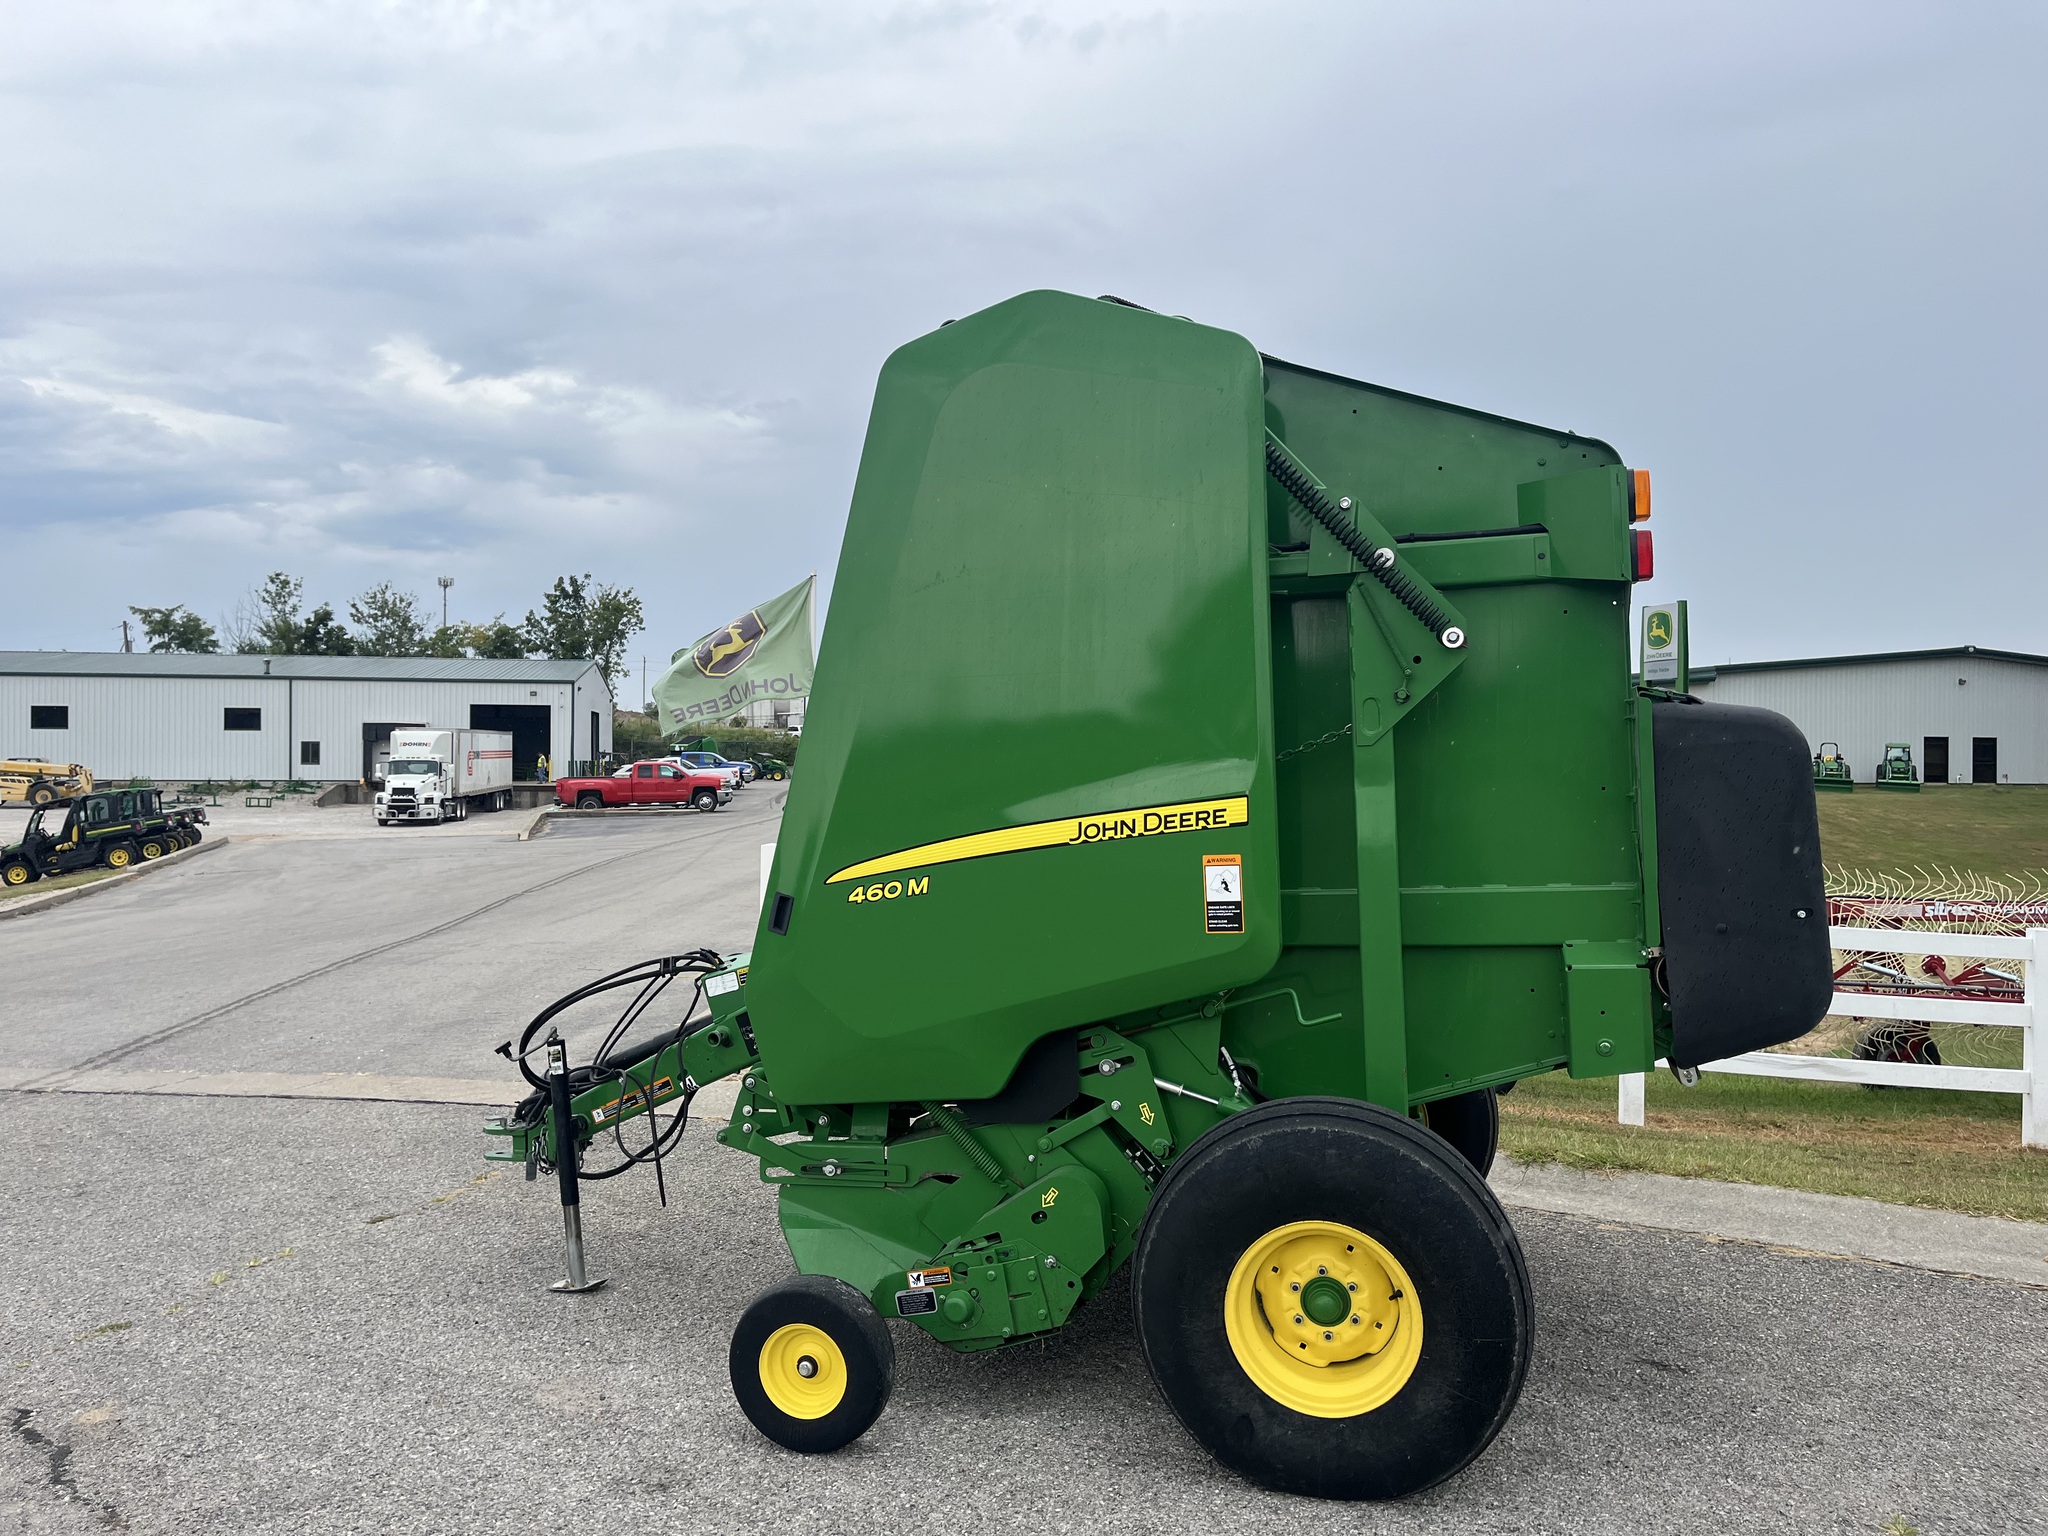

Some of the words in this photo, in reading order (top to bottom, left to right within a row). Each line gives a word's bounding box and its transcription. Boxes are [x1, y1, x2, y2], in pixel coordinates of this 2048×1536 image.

[1069, 818, 1137, 842] JOHN
[1143, 808, 1227, 833] DEERE
[848, 881, 903, 904] 460
[907, 876, 930, 896] M
